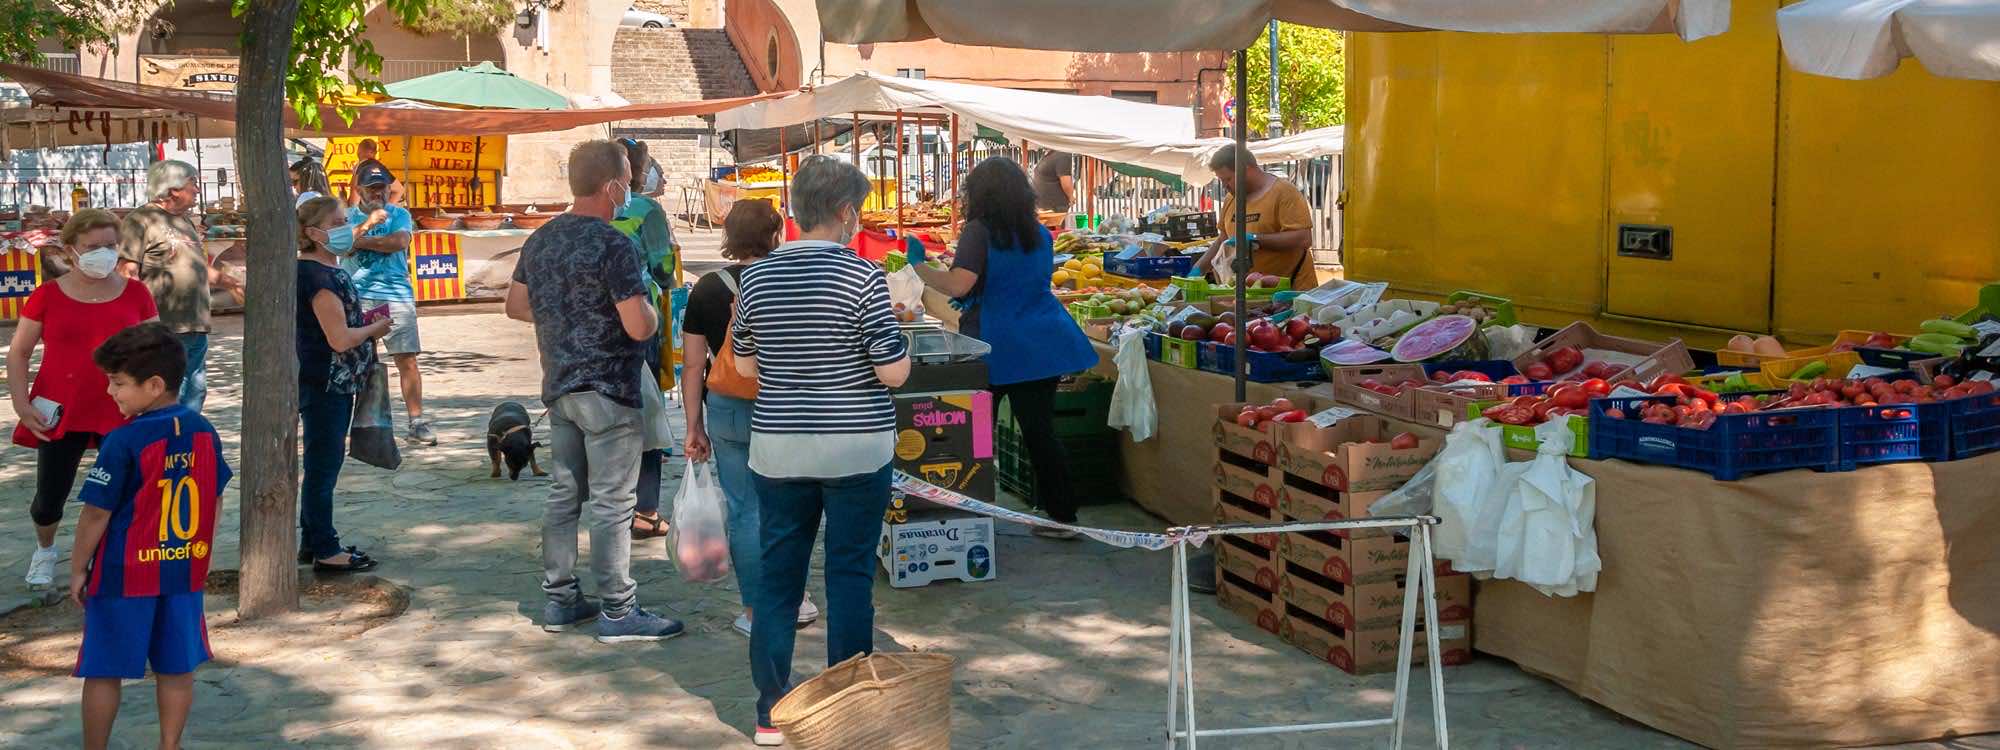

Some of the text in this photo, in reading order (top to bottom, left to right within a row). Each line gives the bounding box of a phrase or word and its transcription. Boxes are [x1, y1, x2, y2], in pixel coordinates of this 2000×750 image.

[195, 73, 238, 84] SINEU
[333, 139, 391, 155] HOY
[423, 138, 487, 154] HONEY
[89, 467, 112, 481] eko
[157, 475, 200, 542] 10
[899, 527, 959, 542] Doramas
[138, 542, 192, 563] unicef
